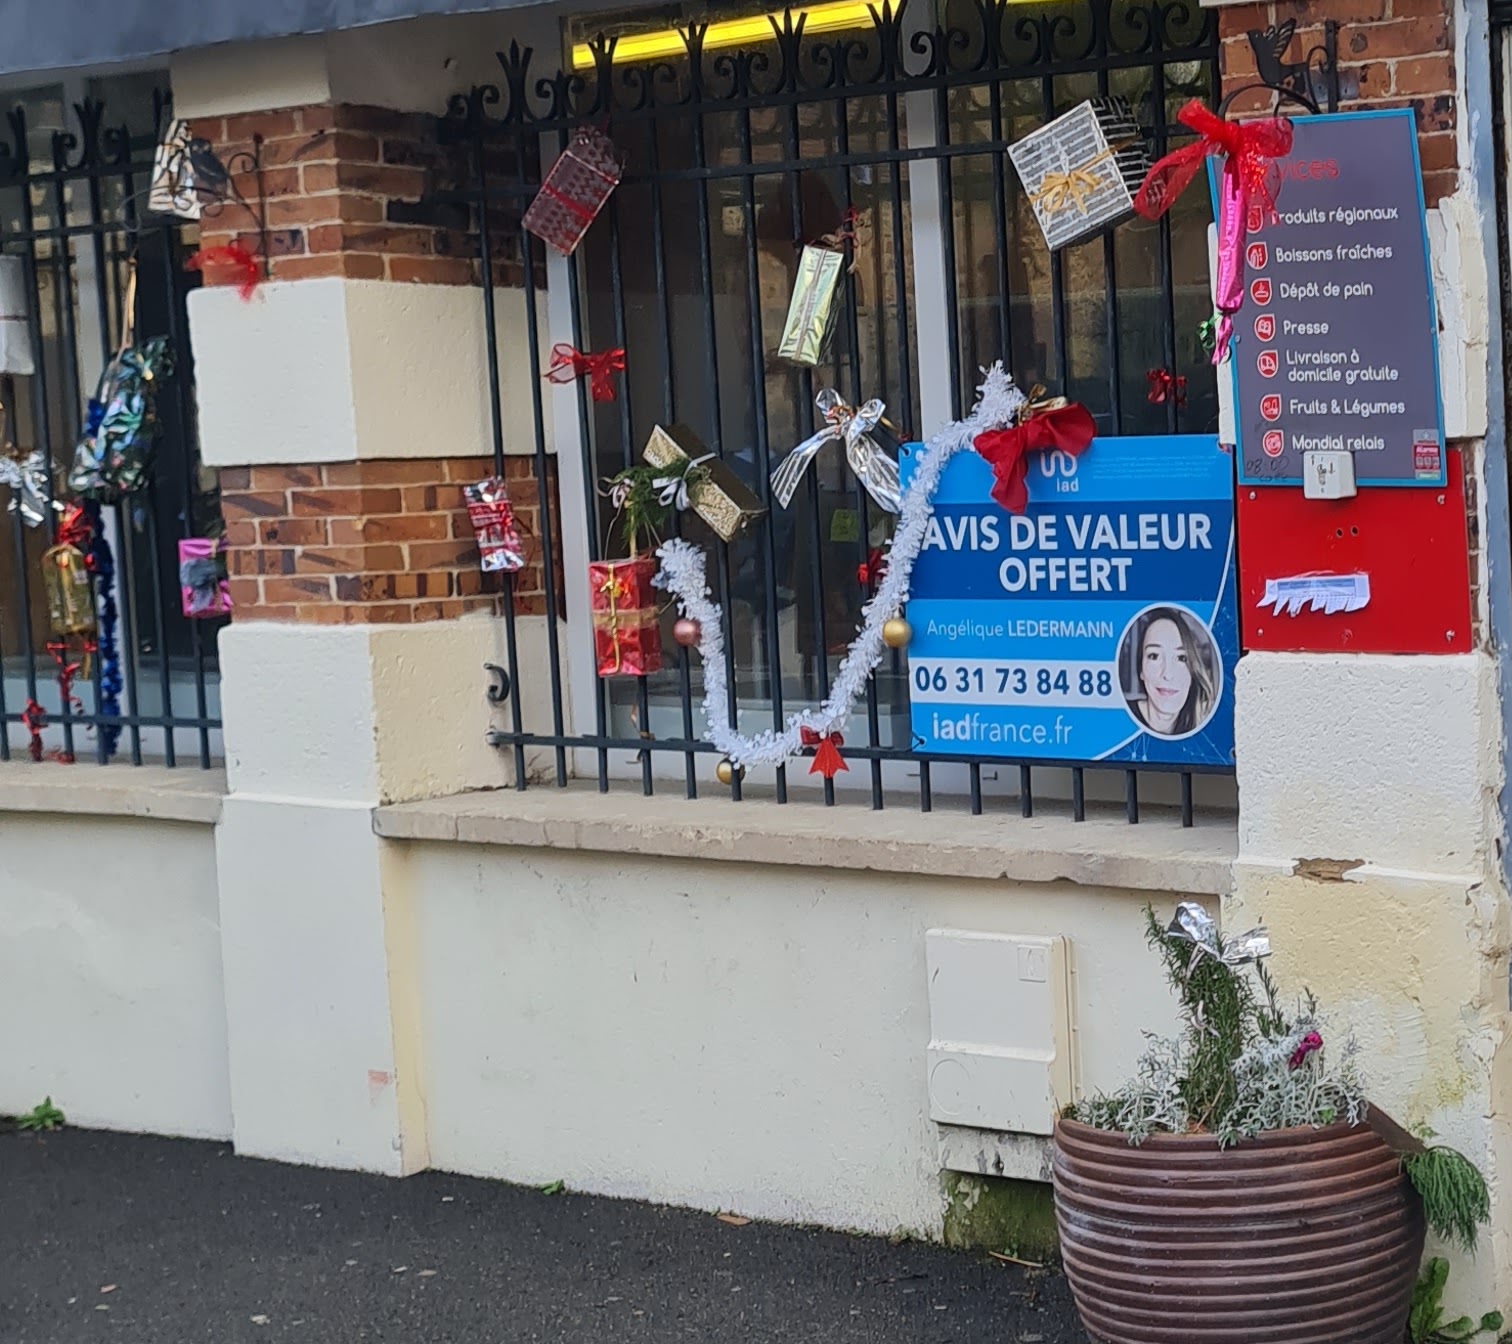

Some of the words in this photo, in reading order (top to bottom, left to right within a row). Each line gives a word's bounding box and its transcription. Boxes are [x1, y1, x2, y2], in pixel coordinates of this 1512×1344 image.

[1329, 206, 1399, 226] régionaux
[1275, 246, 1333, 263] Boissons
[1336, 243, 1393, 261] fraîches
[1280, 281, 1320, 301] Dépôt
[1323, 283, 1341, 297] de
[1344, 283, 1373, 300] pain
[1283, 320, 1330, 335] Presse
[1286, 350, 1348, 365] Livraison
[1351, 348, 1360, 362] à
[1288, 367, 1341, 382] domicile
[1346, 366, 1399, 385] gratuite
[1290, 399, 1328, 415] Fruits
[1331, 400, 1341, 415] &
[1344, 399, 1405, 418] Légumes
[1292, 435, 1344, 451] Mondial
[1347, 435, 1385, 451] relais
[1056, 477, 1080, 493] iad
[922, 515, 1001, 551] AVIS
[1010, 515, 1059, 551] DE
[1066, 513, 1212, 550] VALEUR
[999, 557, 1133, 592] OFFERT
[927, 619, 1004, 641] Angélique
[1007, 620, 1114, 639] LEDERMANN
[915, 666, 947, 692] 06
[955, 667, 984, 693] 31
[995, 668, 1028, 694] 73
[1037, 669, 1070, 695] 84
[1078, 670, 1113, 697] 88
[932, 713, 1074, 745] iadfrance.fr
